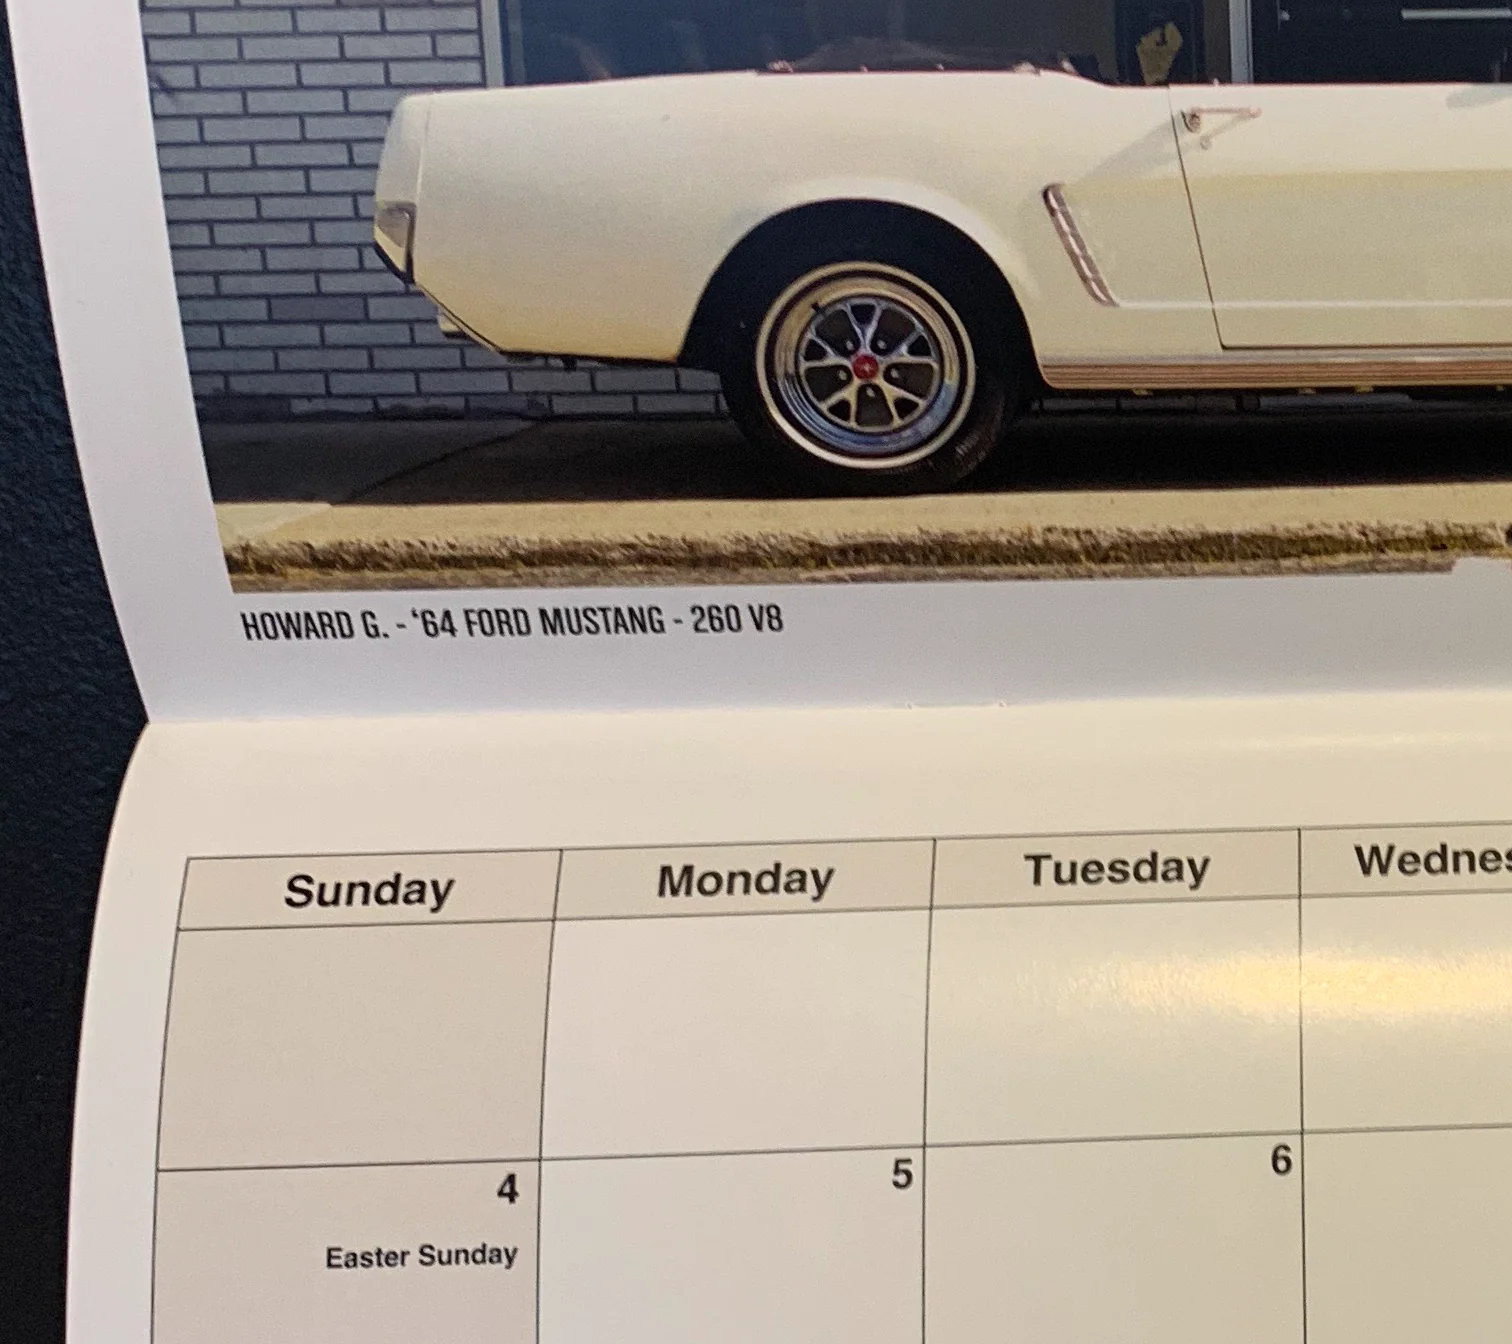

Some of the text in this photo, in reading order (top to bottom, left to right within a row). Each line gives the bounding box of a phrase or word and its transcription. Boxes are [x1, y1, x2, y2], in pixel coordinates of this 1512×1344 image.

[241, 612, 354, 640] HOWARD
[361, 611, 389, 638] G.
[464, 609, 531, 637] FORD
[539, 607, 665, 635] MUSTANG
[691, 605, 741, 633] 260
[748, 605, 783, 631] V8
[285, 873, 454, 913] Sunday
[658, 863, 834, 902] Monday
[1024, 851, 1210, 890] Tuesday
[497, 1174, 518, 1203] 4
[893, 1159, 912, 1189] 5
[1272, 1145, 1292, 1175] 6
[327, 1243, 518, 1269] Easter Sunday
